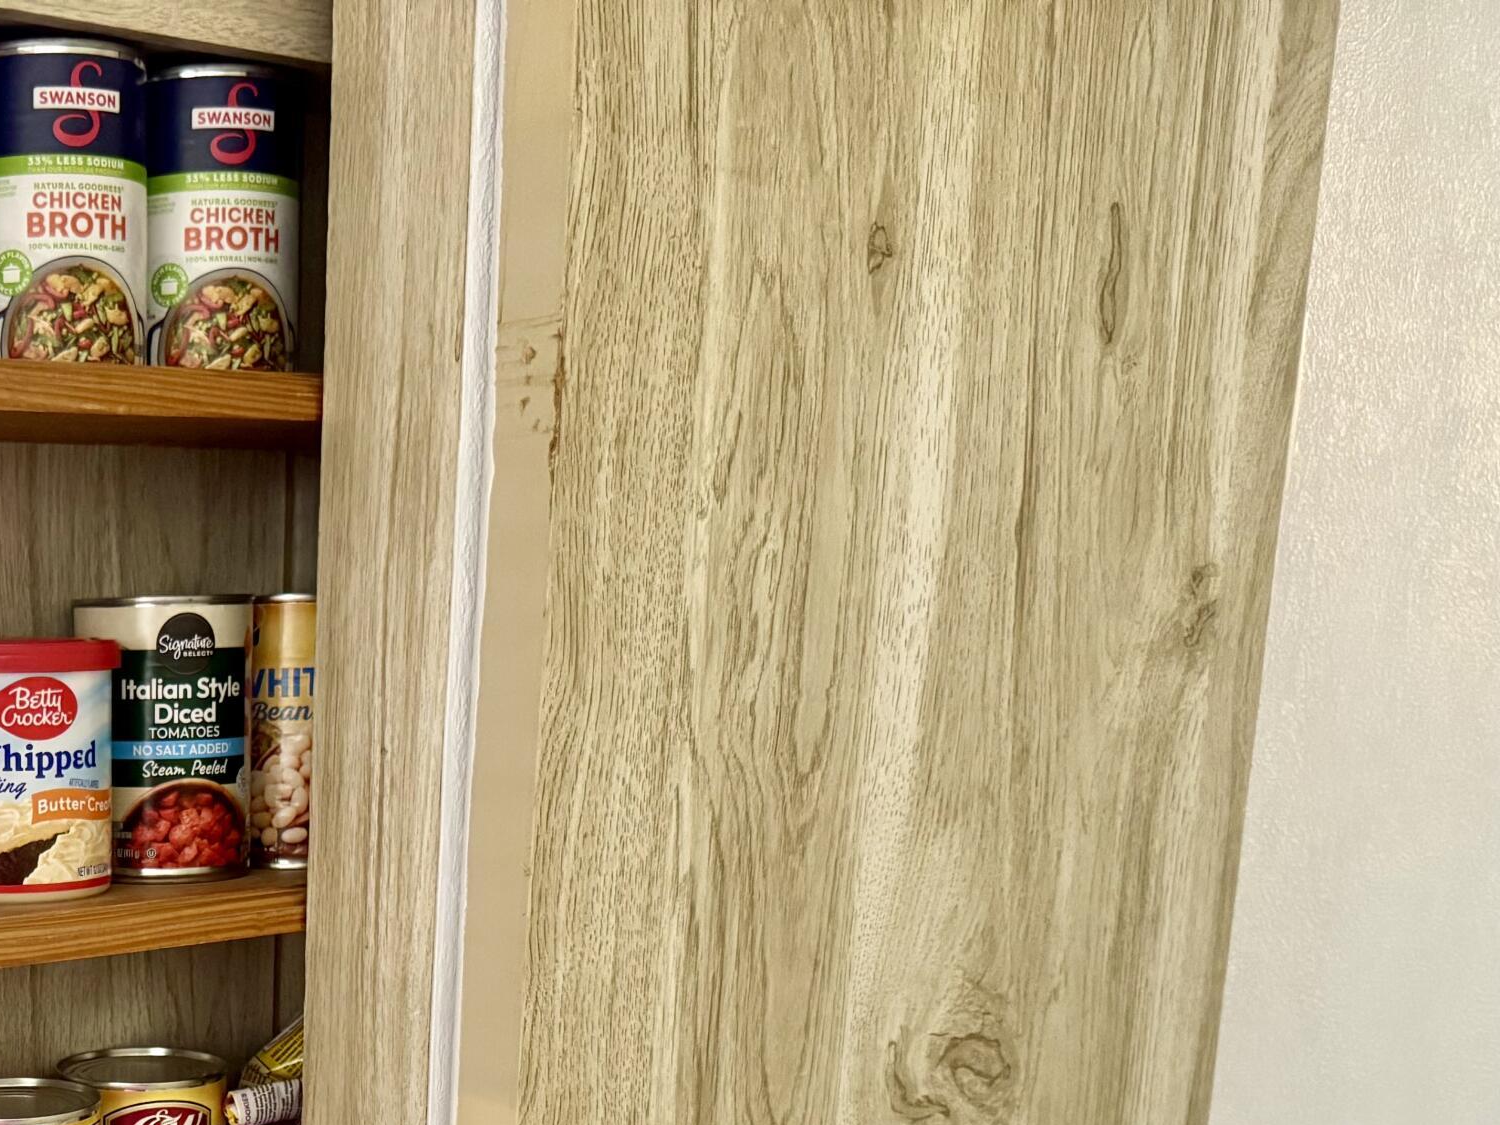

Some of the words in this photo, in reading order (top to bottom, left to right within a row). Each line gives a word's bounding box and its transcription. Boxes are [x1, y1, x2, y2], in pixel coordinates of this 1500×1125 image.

[39, 91, 117, 109] SWANSON
[198, 111, 272, 127] SWANSON
[27, 156, 53, 166] 33%
[56, 156, 83, 166] LESS
[86, 157, 124, 170] SODIUM
[33, 182, 76, 191] NATURAL
[185, 173, 210, 184] 33%
[213, 172, 239, 183] LESS
[32, 191, 122, 212] CHICKEN
[190, 206, 275, 226] CHICKEN
[26, 211, 126, 241] BROTH
[183, 226, 279, 254] BROTH
[159, 634, 214, 660] Signature
[183, 650, 212, 658] SELECT
[9, 686, 63, 710] Betty
[121, 677, 193, 701] Italian
[196, 675, 241, 709] Style
[1, 704, 73, 727] Crocker
[154, 702, 217, 724] Diced
[148, 725, 220, 740] TOMATOES
[132, 744, 154, 757] NO
[156, 743, 184, 756] SALT
[189, 742, 229, 754] ADDED
[142, 761, 186, 778] Steam
[191, 759, 228, 776] Peeled
[37, 798, 85, 814] Butter
